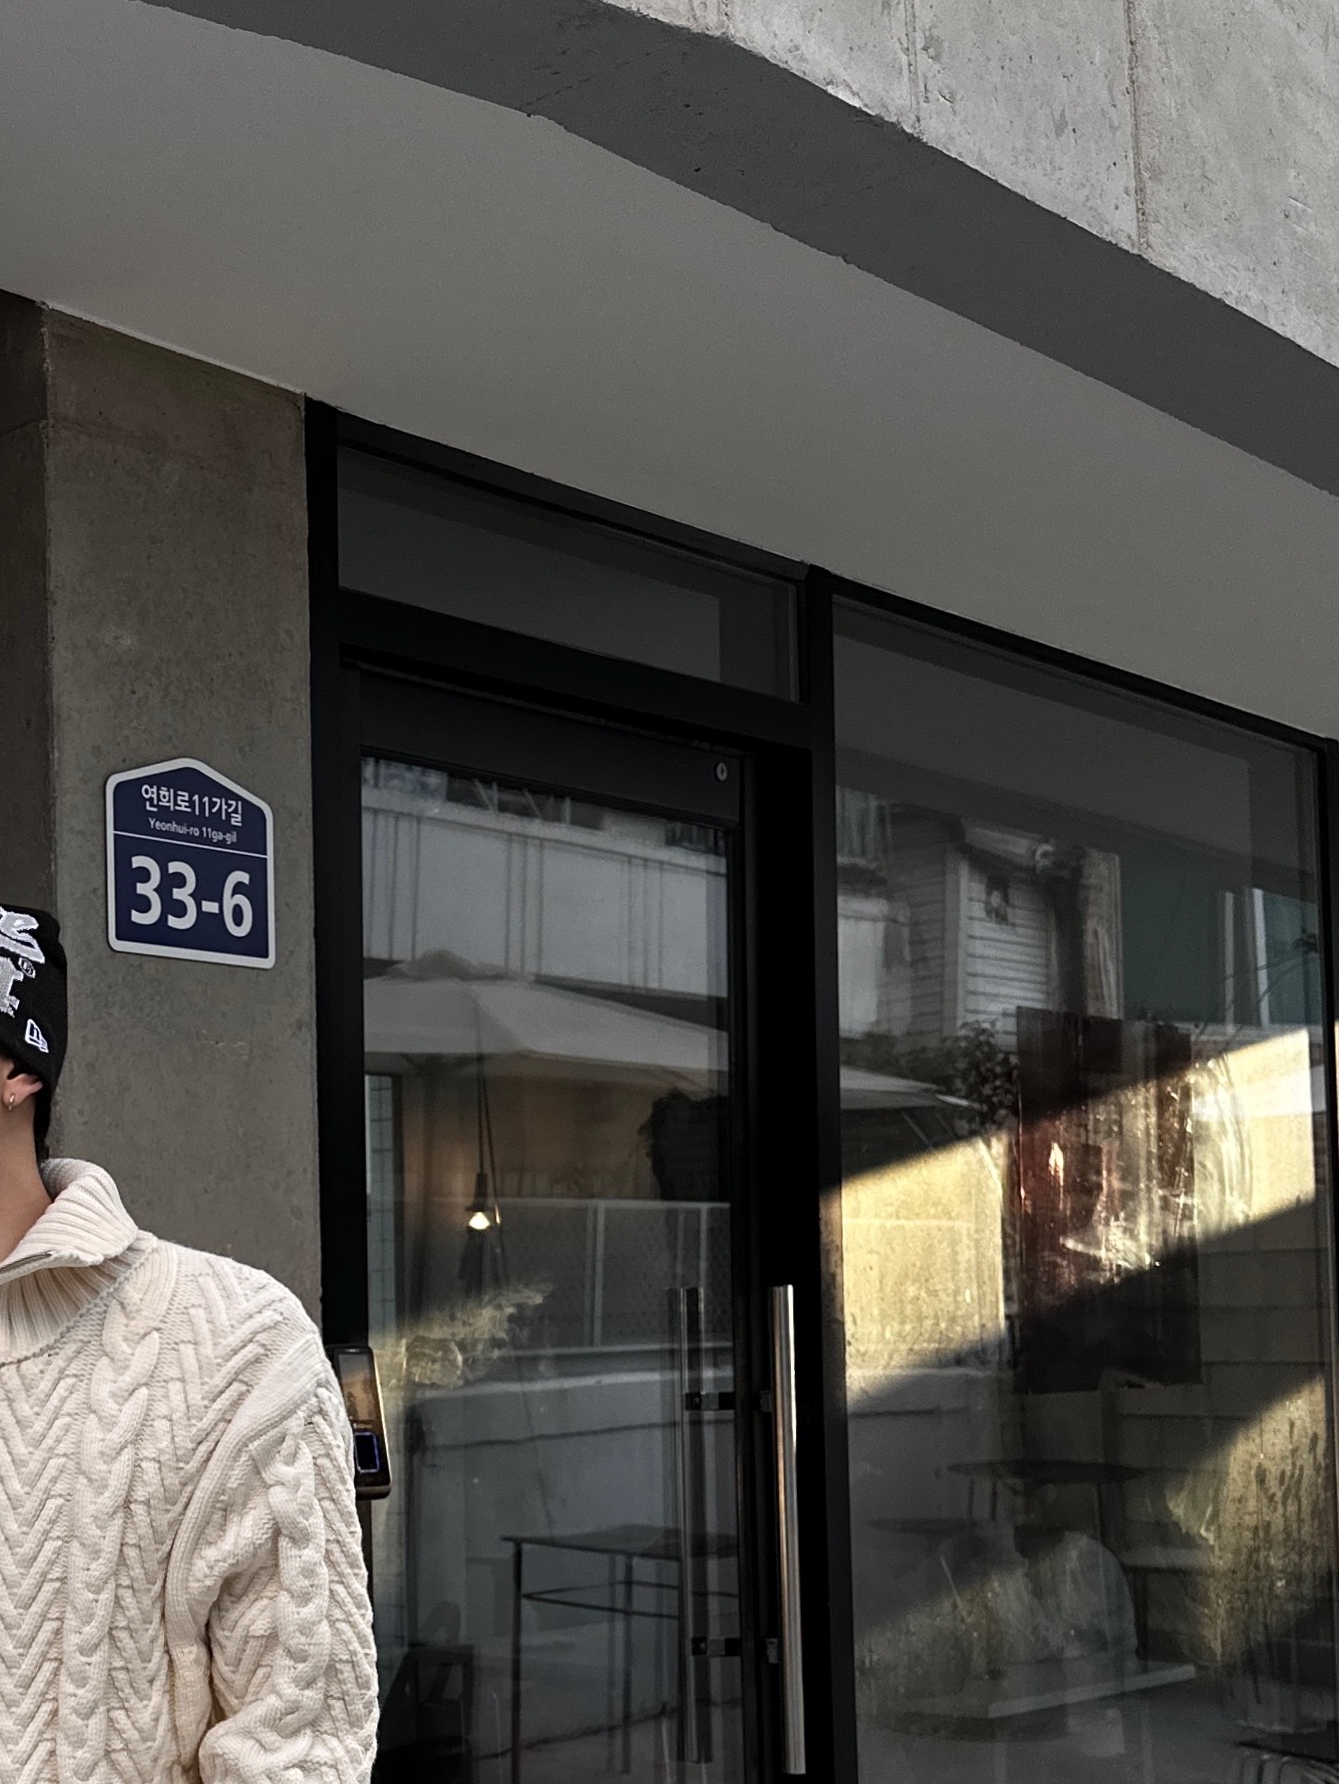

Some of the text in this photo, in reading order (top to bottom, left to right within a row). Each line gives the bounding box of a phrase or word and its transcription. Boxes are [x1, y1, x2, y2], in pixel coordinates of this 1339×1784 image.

[141, 784, 242, 826] 연희로11가길
[148, 817, 237, 844] Yeonhui-ro 11ga-gil
[130, 855, 253, 938] 33-6
